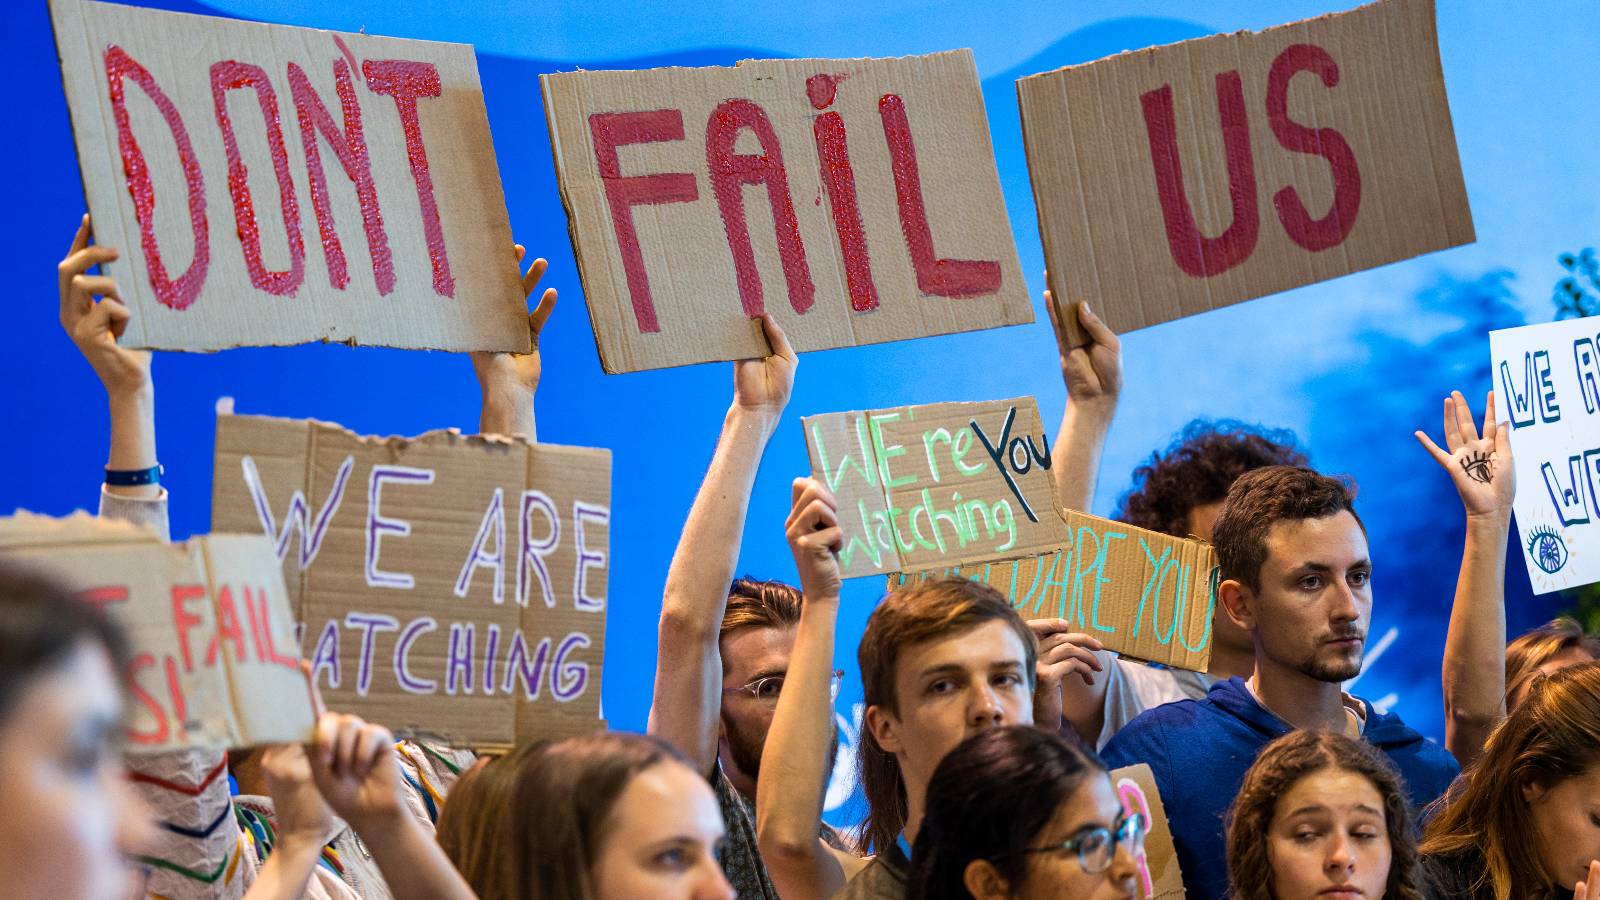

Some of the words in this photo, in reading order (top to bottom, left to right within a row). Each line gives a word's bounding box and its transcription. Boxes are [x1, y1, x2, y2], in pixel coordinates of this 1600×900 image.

[104, 33, 455, 311] DON'T
[1140, 43, 1362, 278] US
[1501, 350, 1560, 430] WE
[1574, 333, 1600, 414] A
[969, 406, 1053, 523] You
[241, 455, 435, 588] WE
[455, 487, 610, 612] ARE
[170, 585, 301, 672] FAIL
[1132, 536, 1220, 653] YOU
[296, 612, 592, 701] ATCHING
